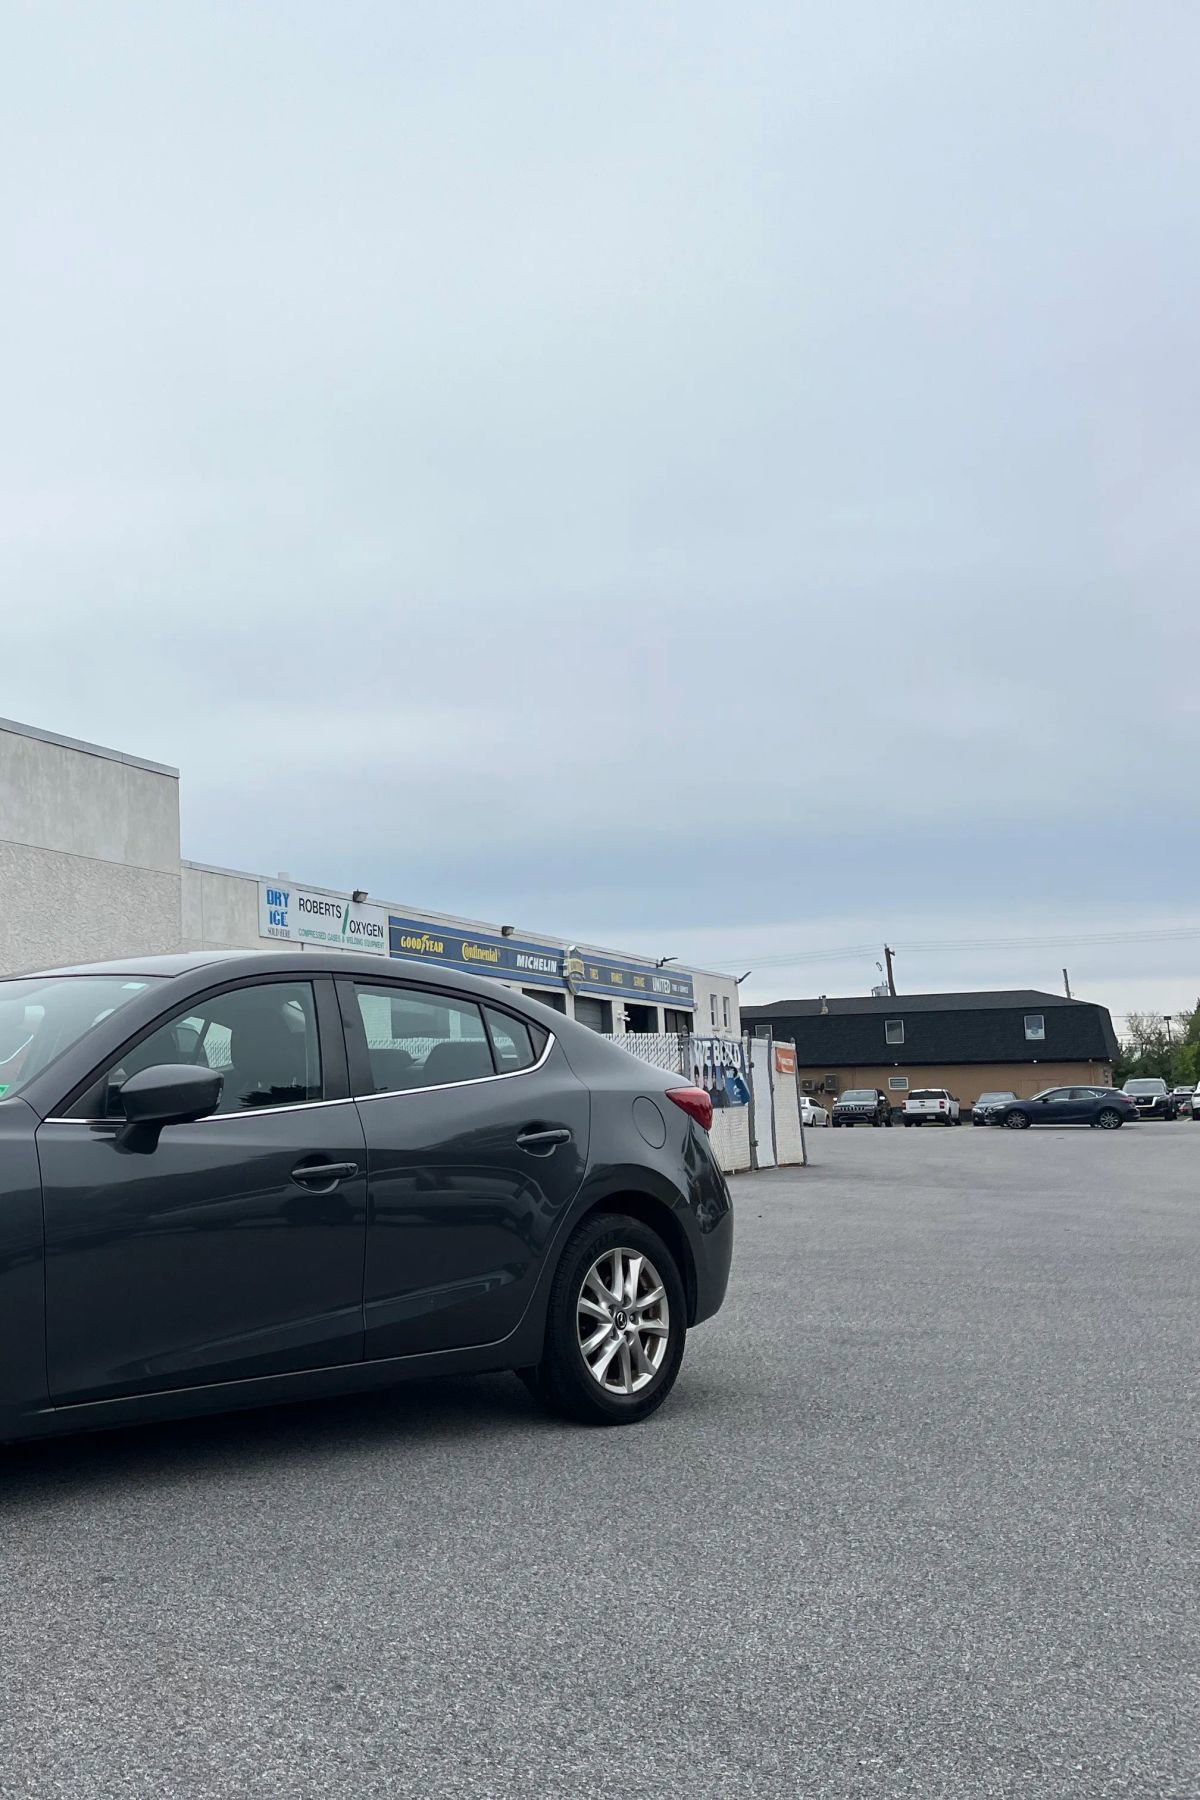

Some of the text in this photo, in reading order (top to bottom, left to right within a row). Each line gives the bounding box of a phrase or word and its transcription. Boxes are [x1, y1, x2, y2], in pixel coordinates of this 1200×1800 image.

[266, 889, 290, 908] DRY
[298, 898, 342, 918] ROBERTS
[269, 910, 288, 927] ICE
[298, 928, 327, 940] COMPRESSED
[349, 920, 384, 938] OXYGEN
[400, 934, 444, 954] GOODYEAR
[462, 942, 498, 962] Continental
[516, 954, 557, 973] MICHELIN
[651, 976, 671, 993] UNITED
